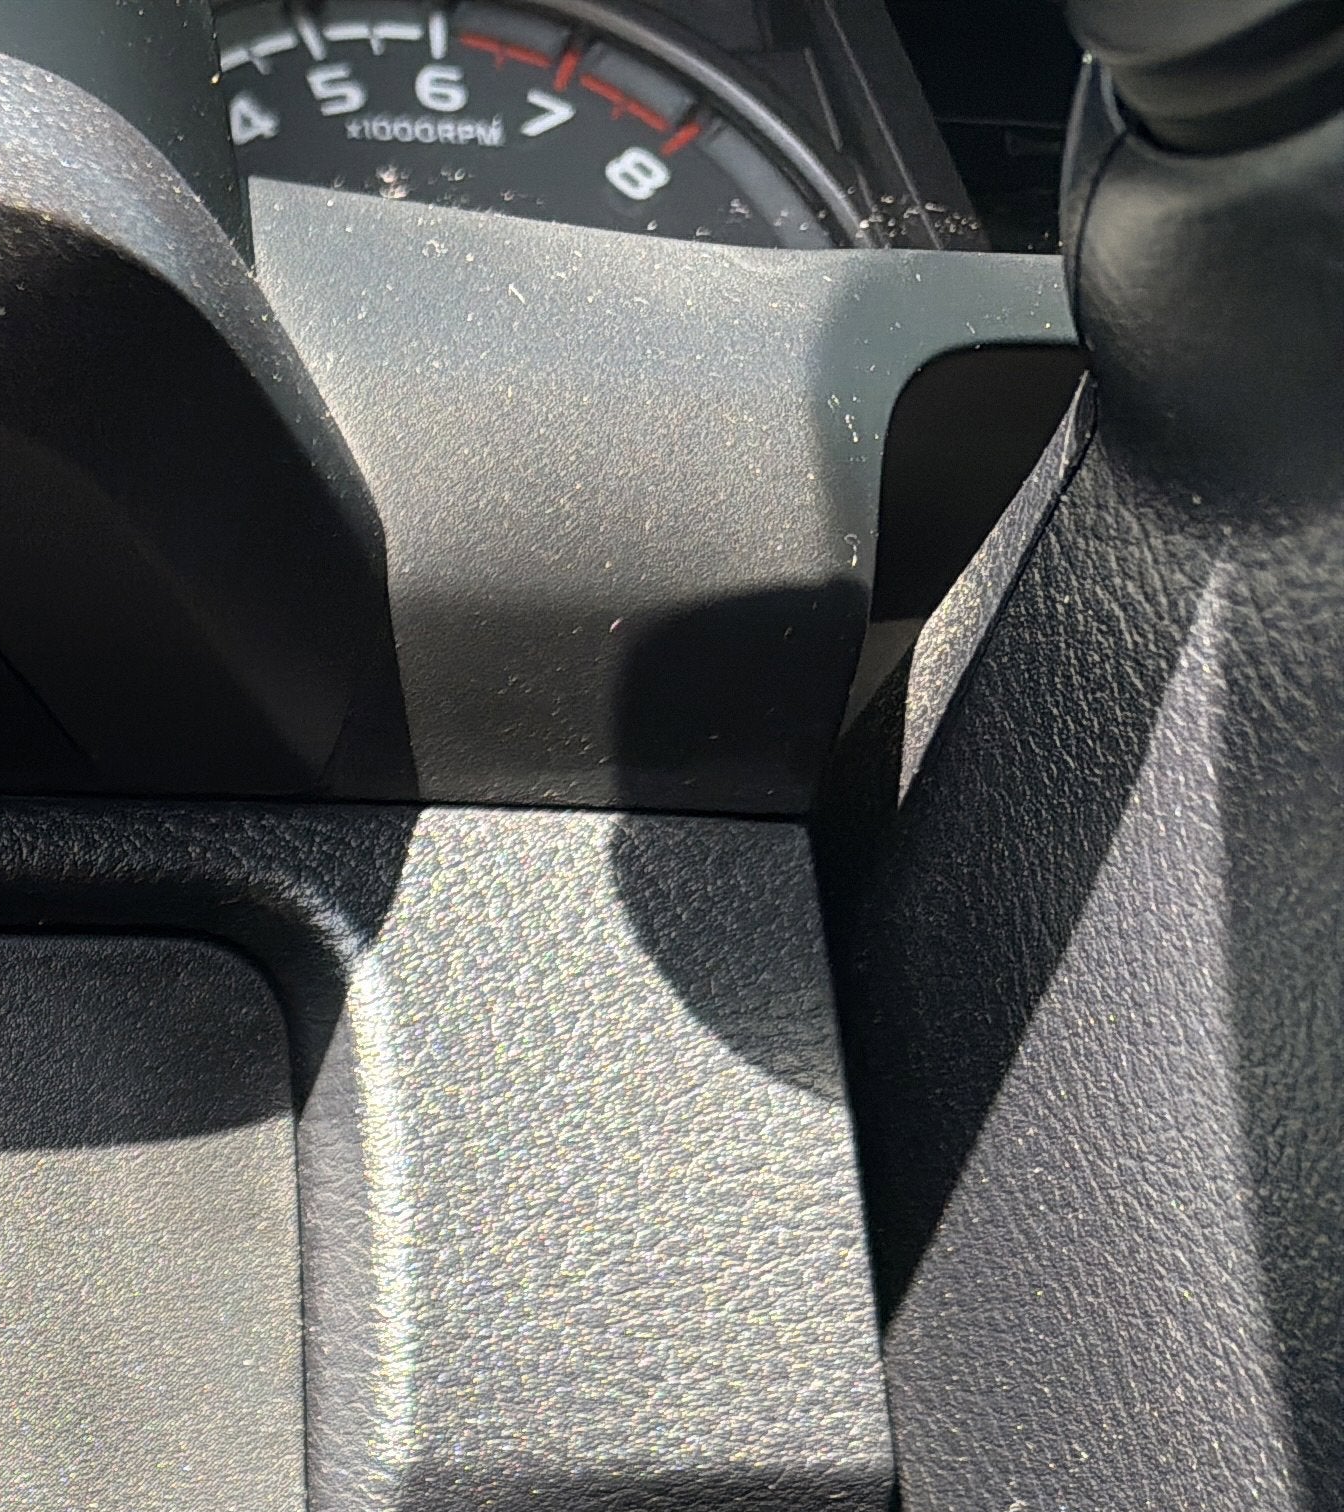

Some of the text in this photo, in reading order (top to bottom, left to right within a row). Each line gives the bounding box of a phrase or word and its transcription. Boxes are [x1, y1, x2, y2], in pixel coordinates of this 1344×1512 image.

[306, 63, 367, 117] 5
[414, 63, 468, 113] 6
[520, 88, 576, 138] 7
[228, 93, 279, 145] 4
[605, 146, 672, 202] 8
